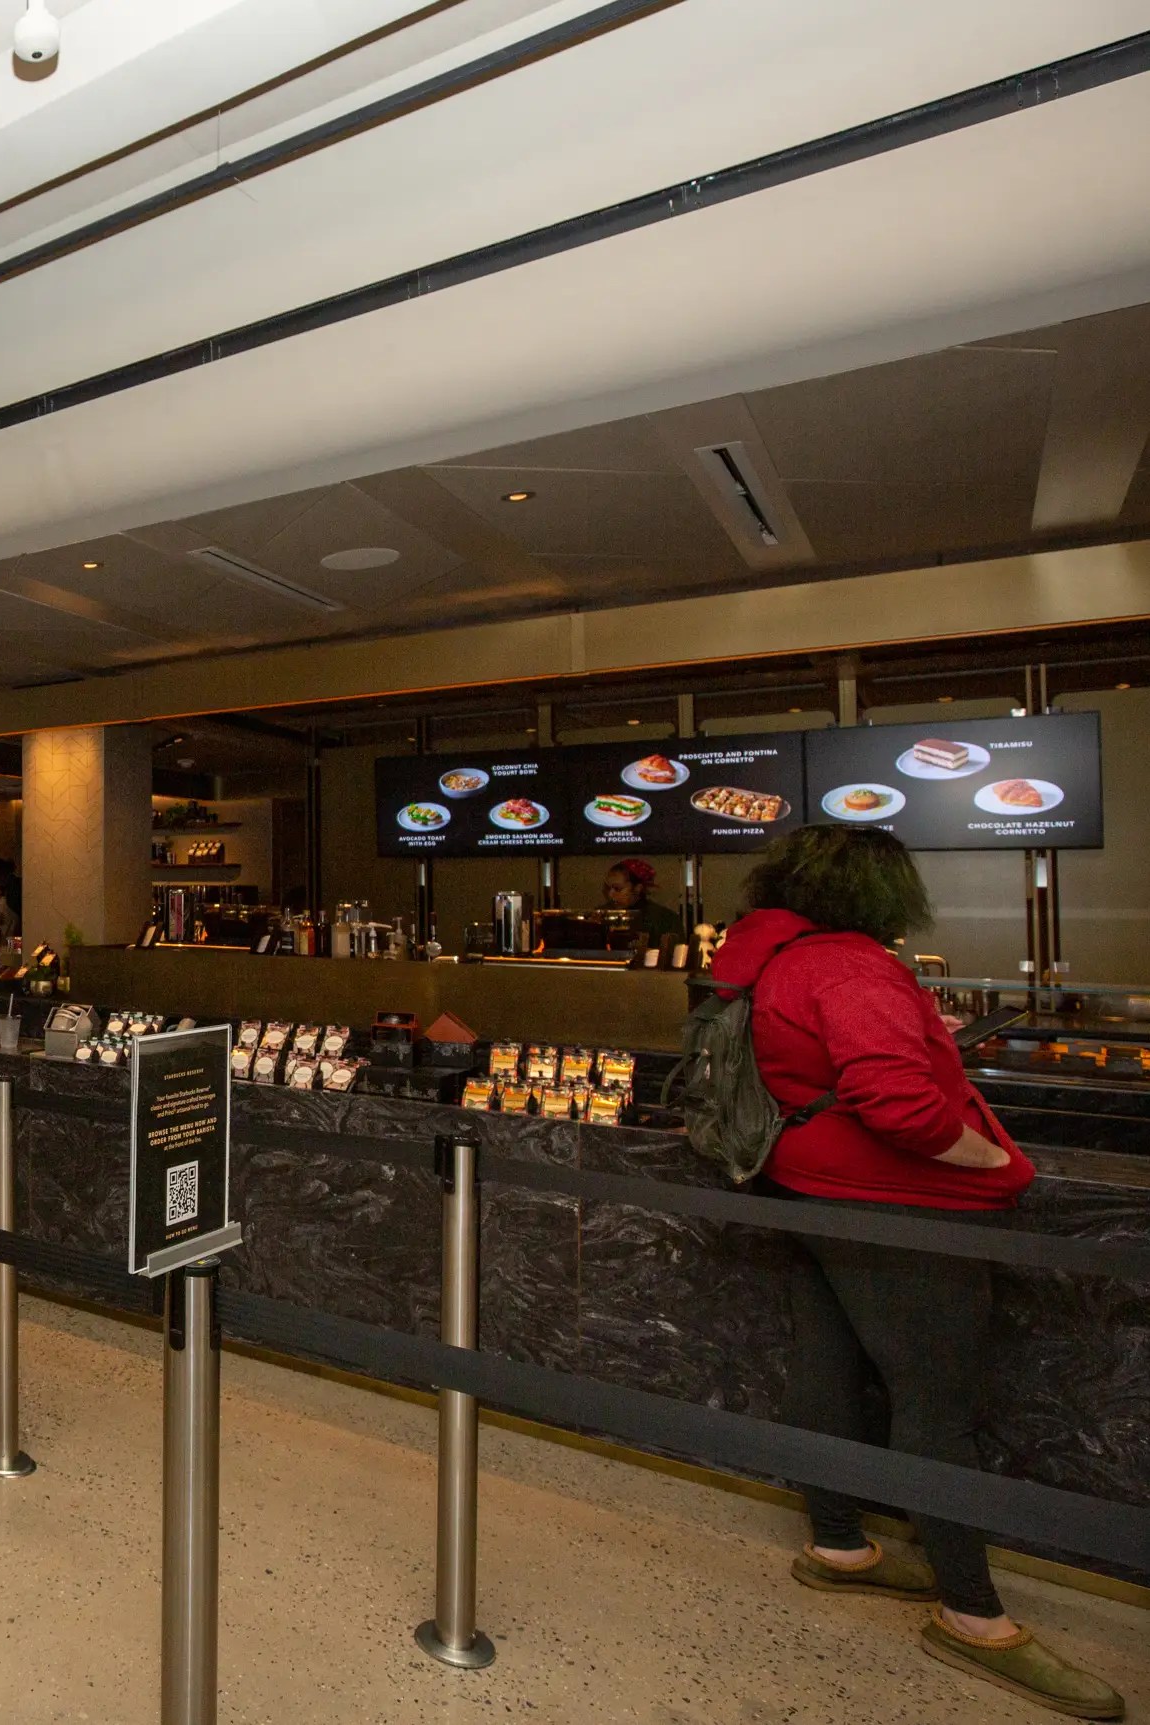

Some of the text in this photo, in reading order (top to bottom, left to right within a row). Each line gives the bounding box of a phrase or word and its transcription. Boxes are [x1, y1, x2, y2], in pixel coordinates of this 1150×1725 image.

[990, 741, 1033, 749] TIRAMISU
[148, 1129, 168, 1138] BROWSE
[180, 1122, 194, 1130] MENU
[150, 1137, 166, 1146] ORDER
[196, 1125, 215, 1134] BARISTA
